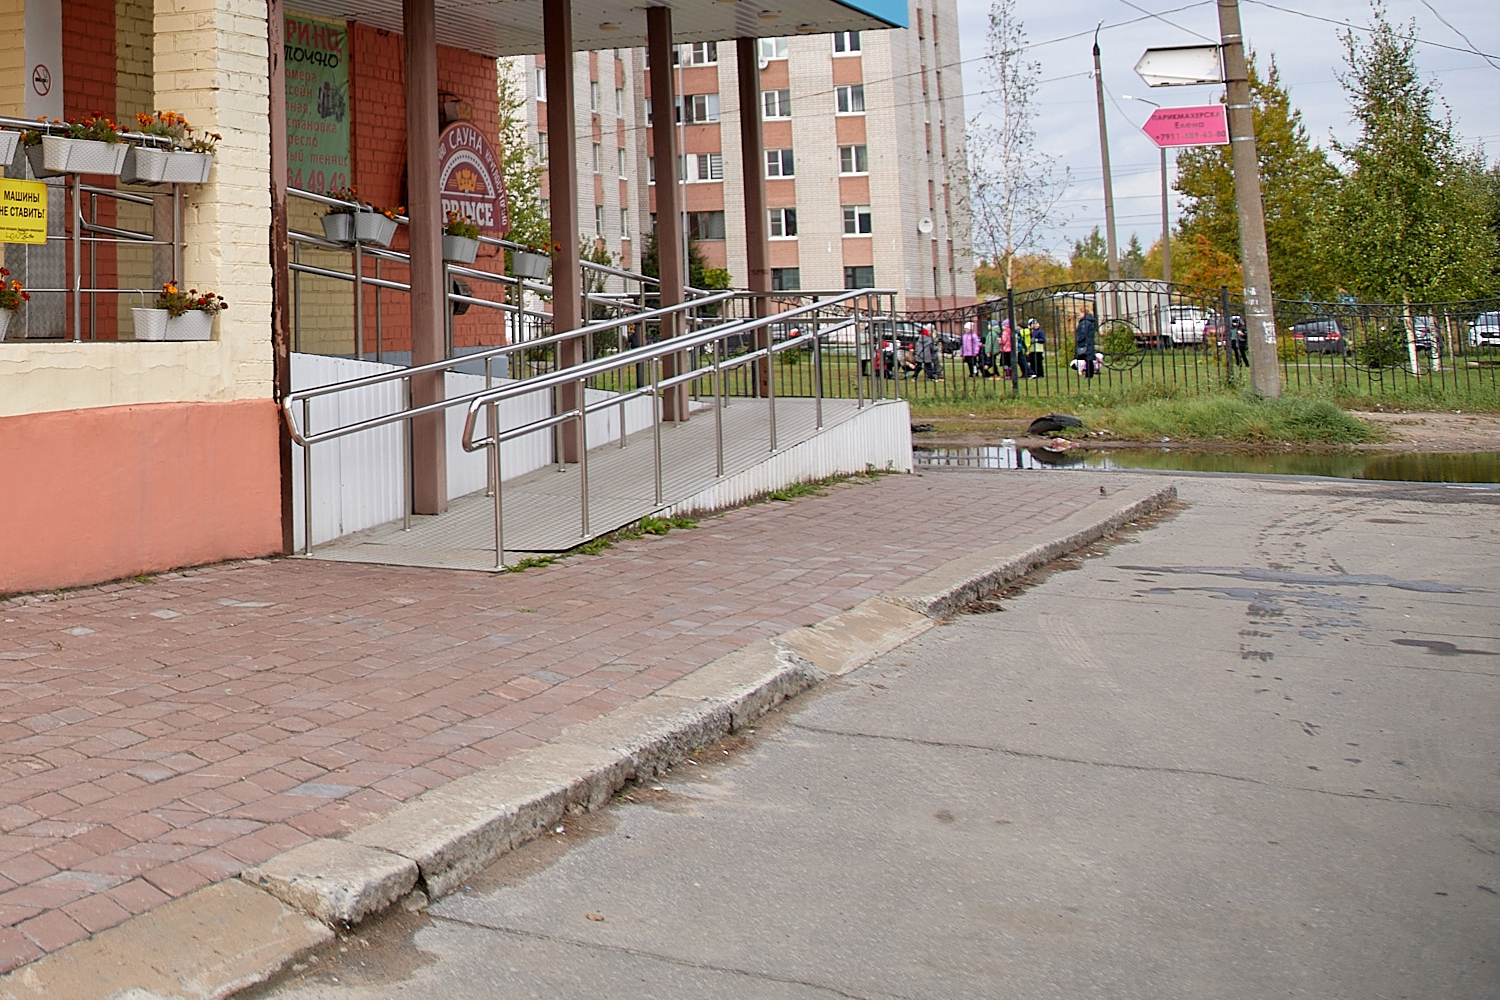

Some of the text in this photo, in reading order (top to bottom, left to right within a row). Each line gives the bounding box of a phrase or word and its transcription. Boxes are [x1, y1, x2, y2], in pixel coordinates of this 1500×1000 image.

[285, 83, 313, 99] сейн
[448, 127, 484, 155] САУНА
[310, 153, 349, 167] теннис
[307, 169, 326, 195] 49
[3, 190, 40, 203] МАШИНЫ
[10, 206, 45, 219] СТАВИТЬ!
[441, 198, 494, 227] PRINCE
